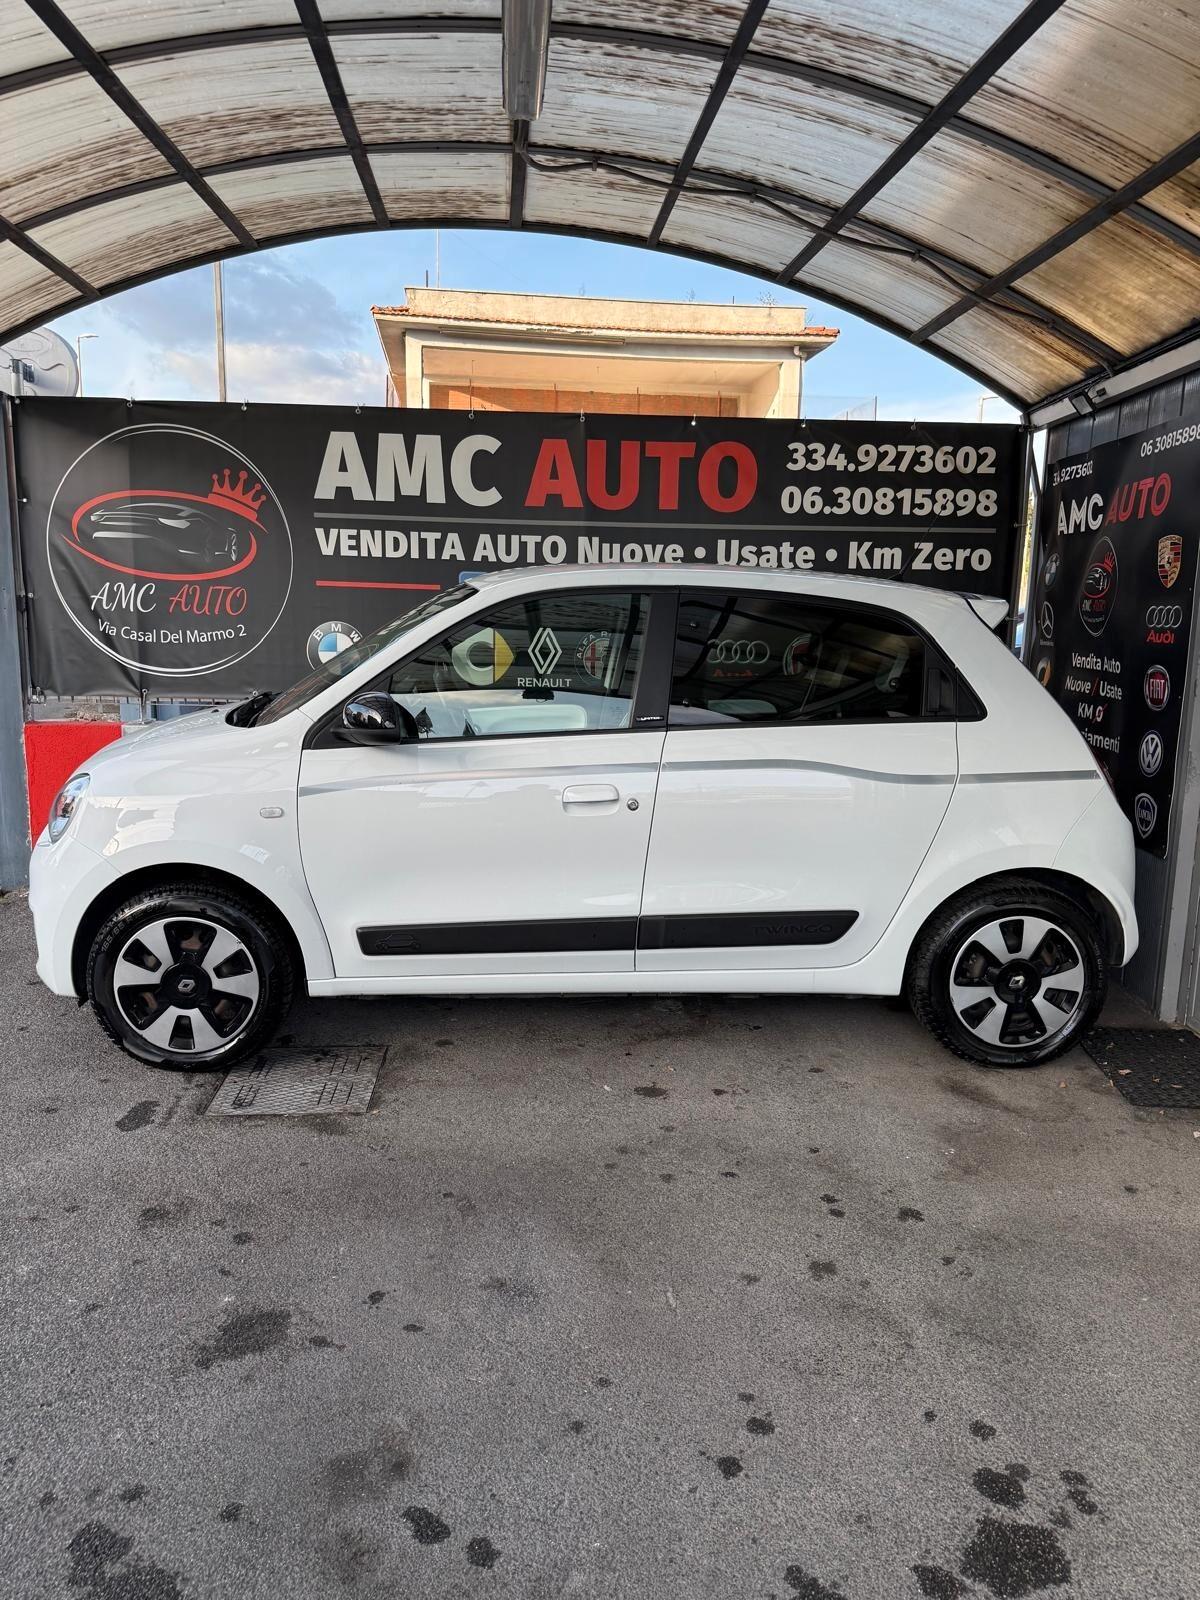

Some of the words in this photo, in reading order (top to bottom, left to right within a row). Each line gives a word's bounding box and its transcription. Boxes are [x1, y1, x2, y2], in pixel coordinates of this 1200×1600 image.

[785, 442, 997, 475] 334.9273602
[1141, 439, 1154, 458] 06
[313, 430, 503, 508] AMC
[523, 438, 758, 514] AUTO
[780, 485, 998, 518] 06.30815898
[1057, 493, 1104, 536] AMC
[1104, 472, 1172, 527] AUTO
[314, 527, 466, 562] VENDITA
[472, 533, 568, 565] AUTO
[577, 536, 685, 564] Nuove
[716, 539, 816, 570] Usate
[848, 541, 902, 571] Km
[911, 542, 993, 572] Zero
[90, 581, 157, 613] AMC
[169, 583, 248, 616] AUTO
[98, 618, 117, 637] Via
[120, 626, 157, 644] Casal
[160, 628, 183, 644] Del
[186, 627, 235, 644] Marmo
[236, 624, 247, 637] 2
[312, 622, 362, 643] BMW
[1146, 629, 1175, 645] Audi
[1072, 652, 1102, 671] Vendita
[1103, 655, 1121, 674] Auto
[516, 676, 573, 689] RENAULT
[1064, 675, 1091, 694] Nuove
[1099, 680, 1123, 700] Usate
[1149, 678, 1165, 700] FIAT
[1077, 702, 1094, 720] KM
[1095, 705, 1104, 722] 0
[752, 924, 833, 936] TWINGO
